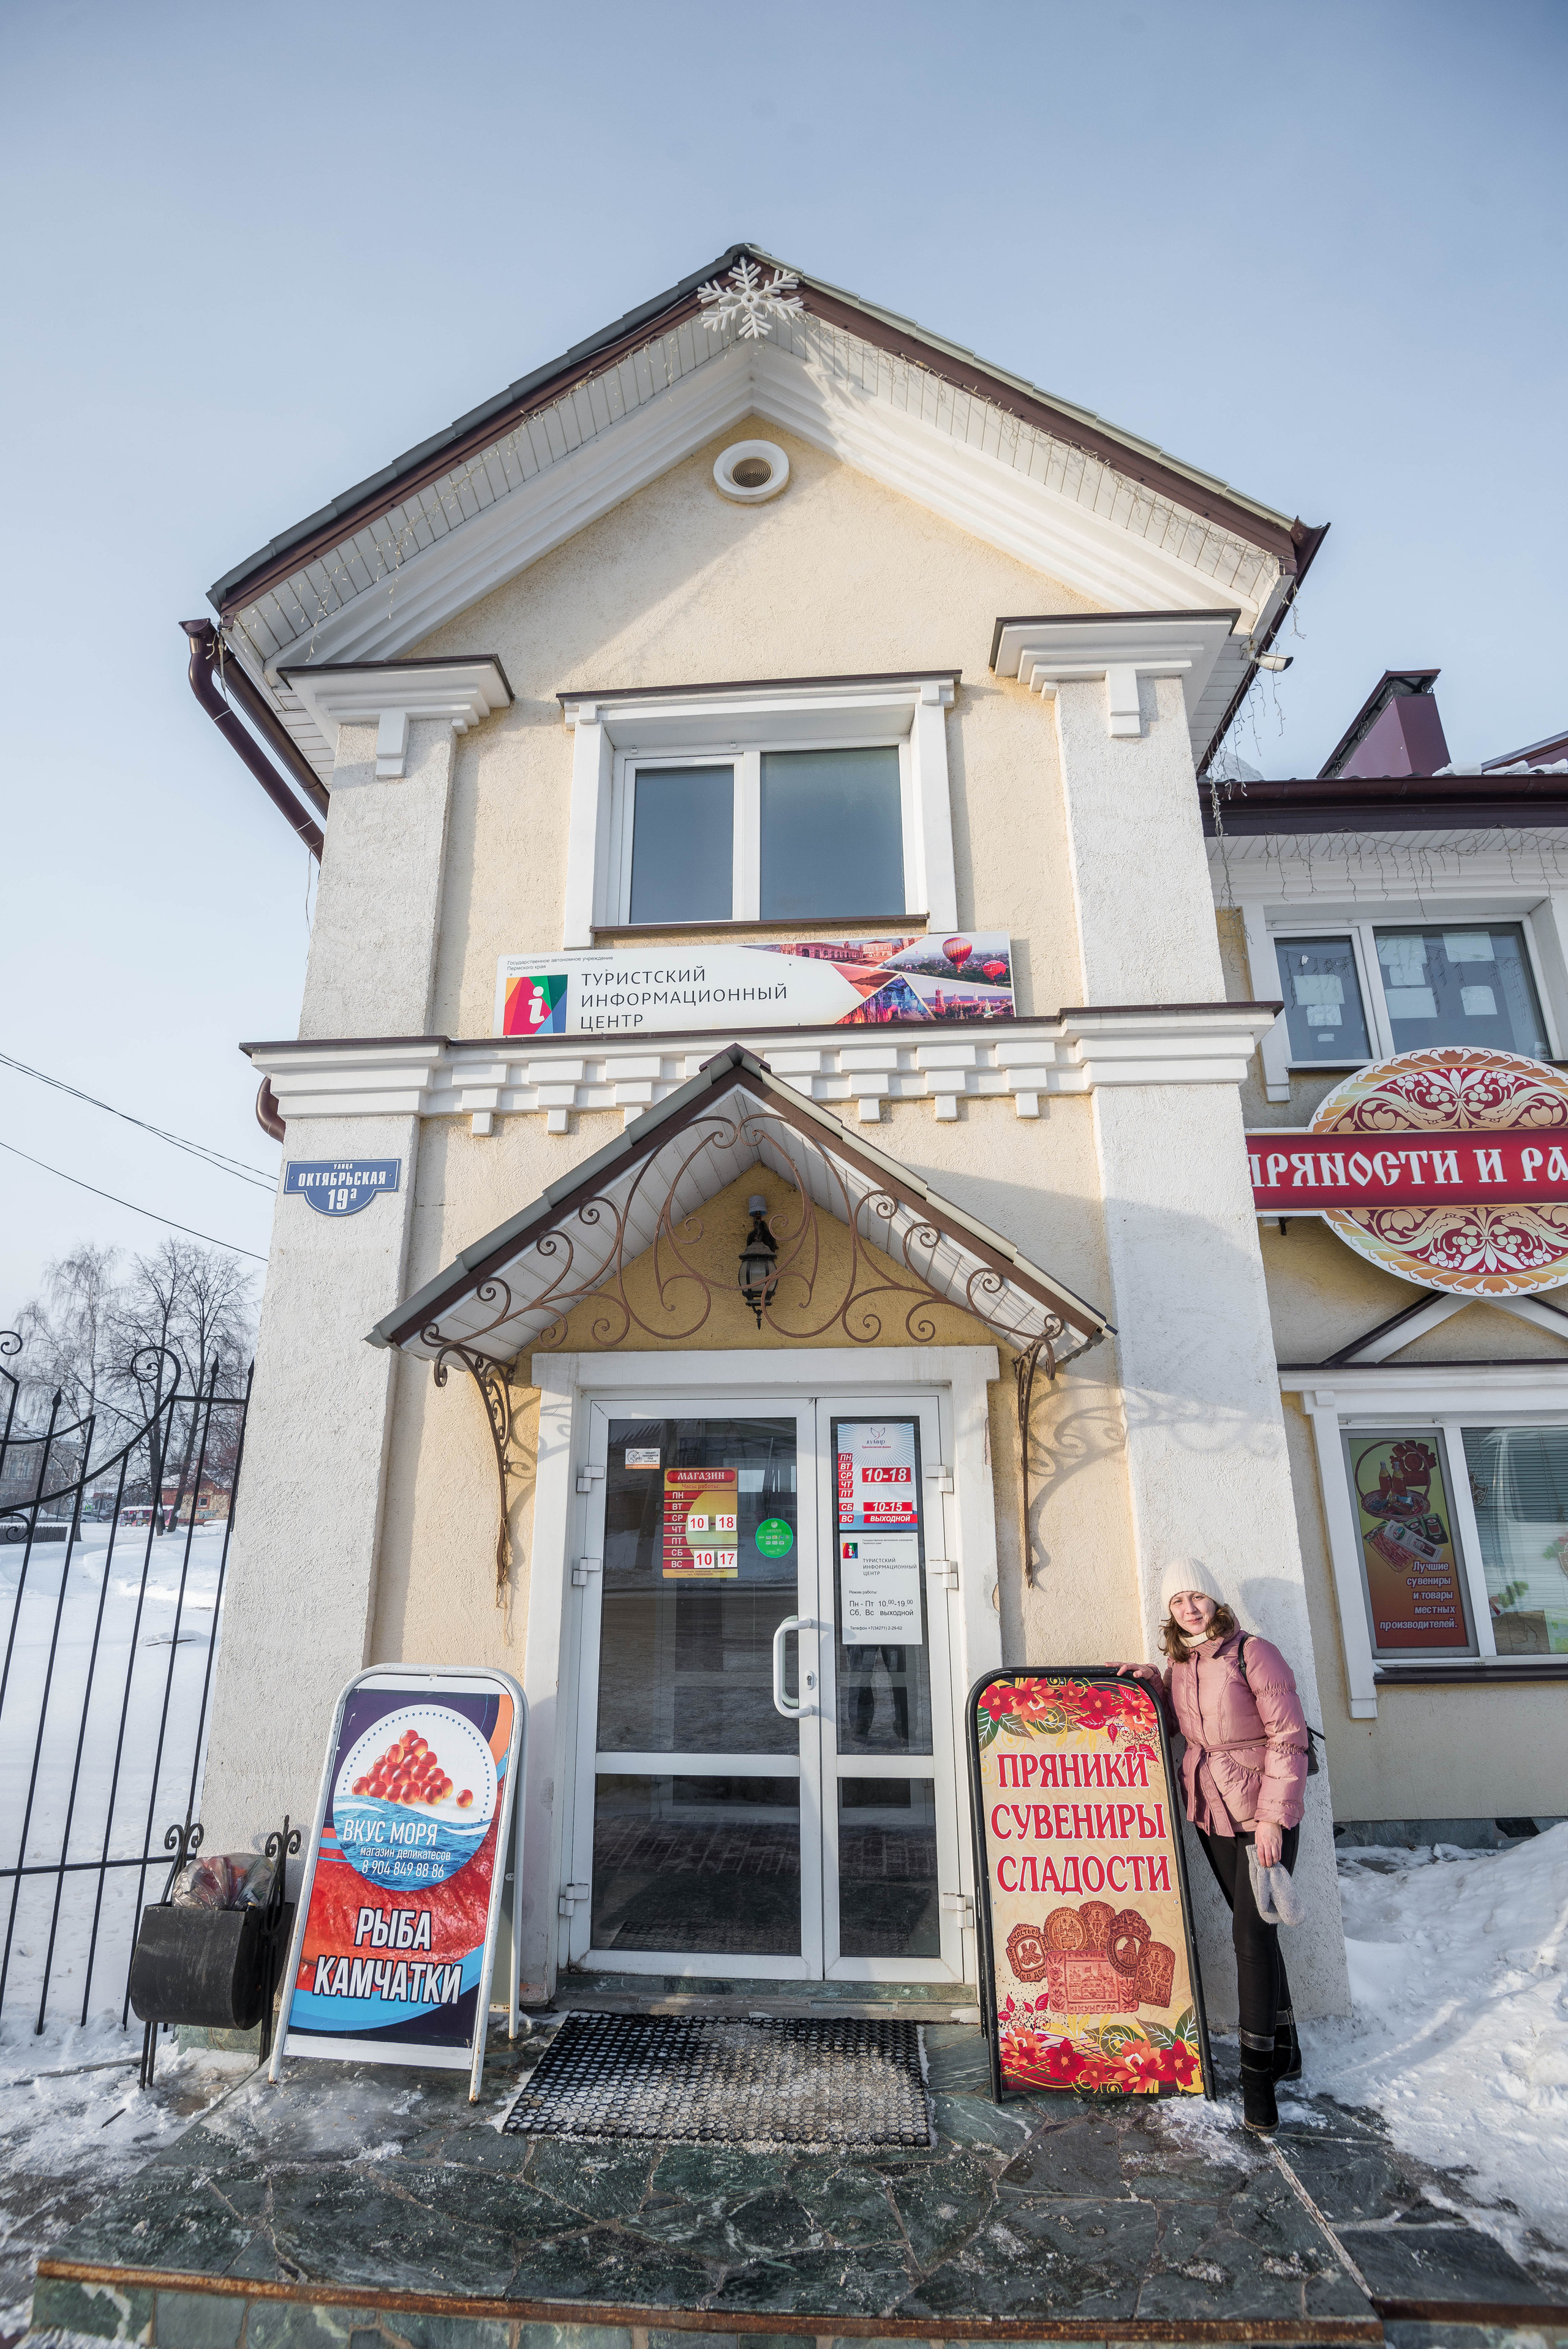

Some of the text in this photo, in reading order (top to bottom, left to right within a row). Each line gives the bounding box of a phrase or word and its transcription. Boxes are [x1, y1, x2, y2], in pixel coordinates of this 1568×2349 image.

[581, 966, 706, 986] ТУРИСТСКИЙ
[581, 983, 787, 1008] ИНФОРМАЦИОННЫЙ
[581, 1014, 643, 1032] ЦЕНТР
[1473, 1148, 1507, 1183] И
[298, 1171, 386, 1187] ОКТЯБРЬСКАЯ
[677, 1472, 725, 1480] МАГАЗИН
[865, 1468, 907, 1482] 10-18
[873, 1502, 903, 1512] 10-15
[690, 1518, 704, 1528] 10
[719, 1517, 734, 1528] 18
[696, 1553, 712, 1565] 10
[720, 1553, 735, 1564] 17
[1413, 1561, 1449, 1573] Лучшие
[1406, 1577, 1451, 1588] сувениры
[1421, 1592, 1453, 1601] товары
[1380, 1618, 1457, 1631] производителей.
[997, 1753, 1150, 1788] ПРЯНИКИ
[991, 1804, 1167, 1840] СУВЕНИРЫ
[343, 1819, 438, 1846] ВКУС МОРЯ
[360, 1847, 451, 1861] магазин деликатесов
[362, 1860, 444, 1878] 8 904 849 88 86
[997, 1855, 1172, 1896] СЛАДОСТИ
[355, 1908, 431, 1950] РЫБА
[1115, 1964, 1135, 1975] КУНГ
[313, 1956, 462, 2004] КАМЧАТКИ
